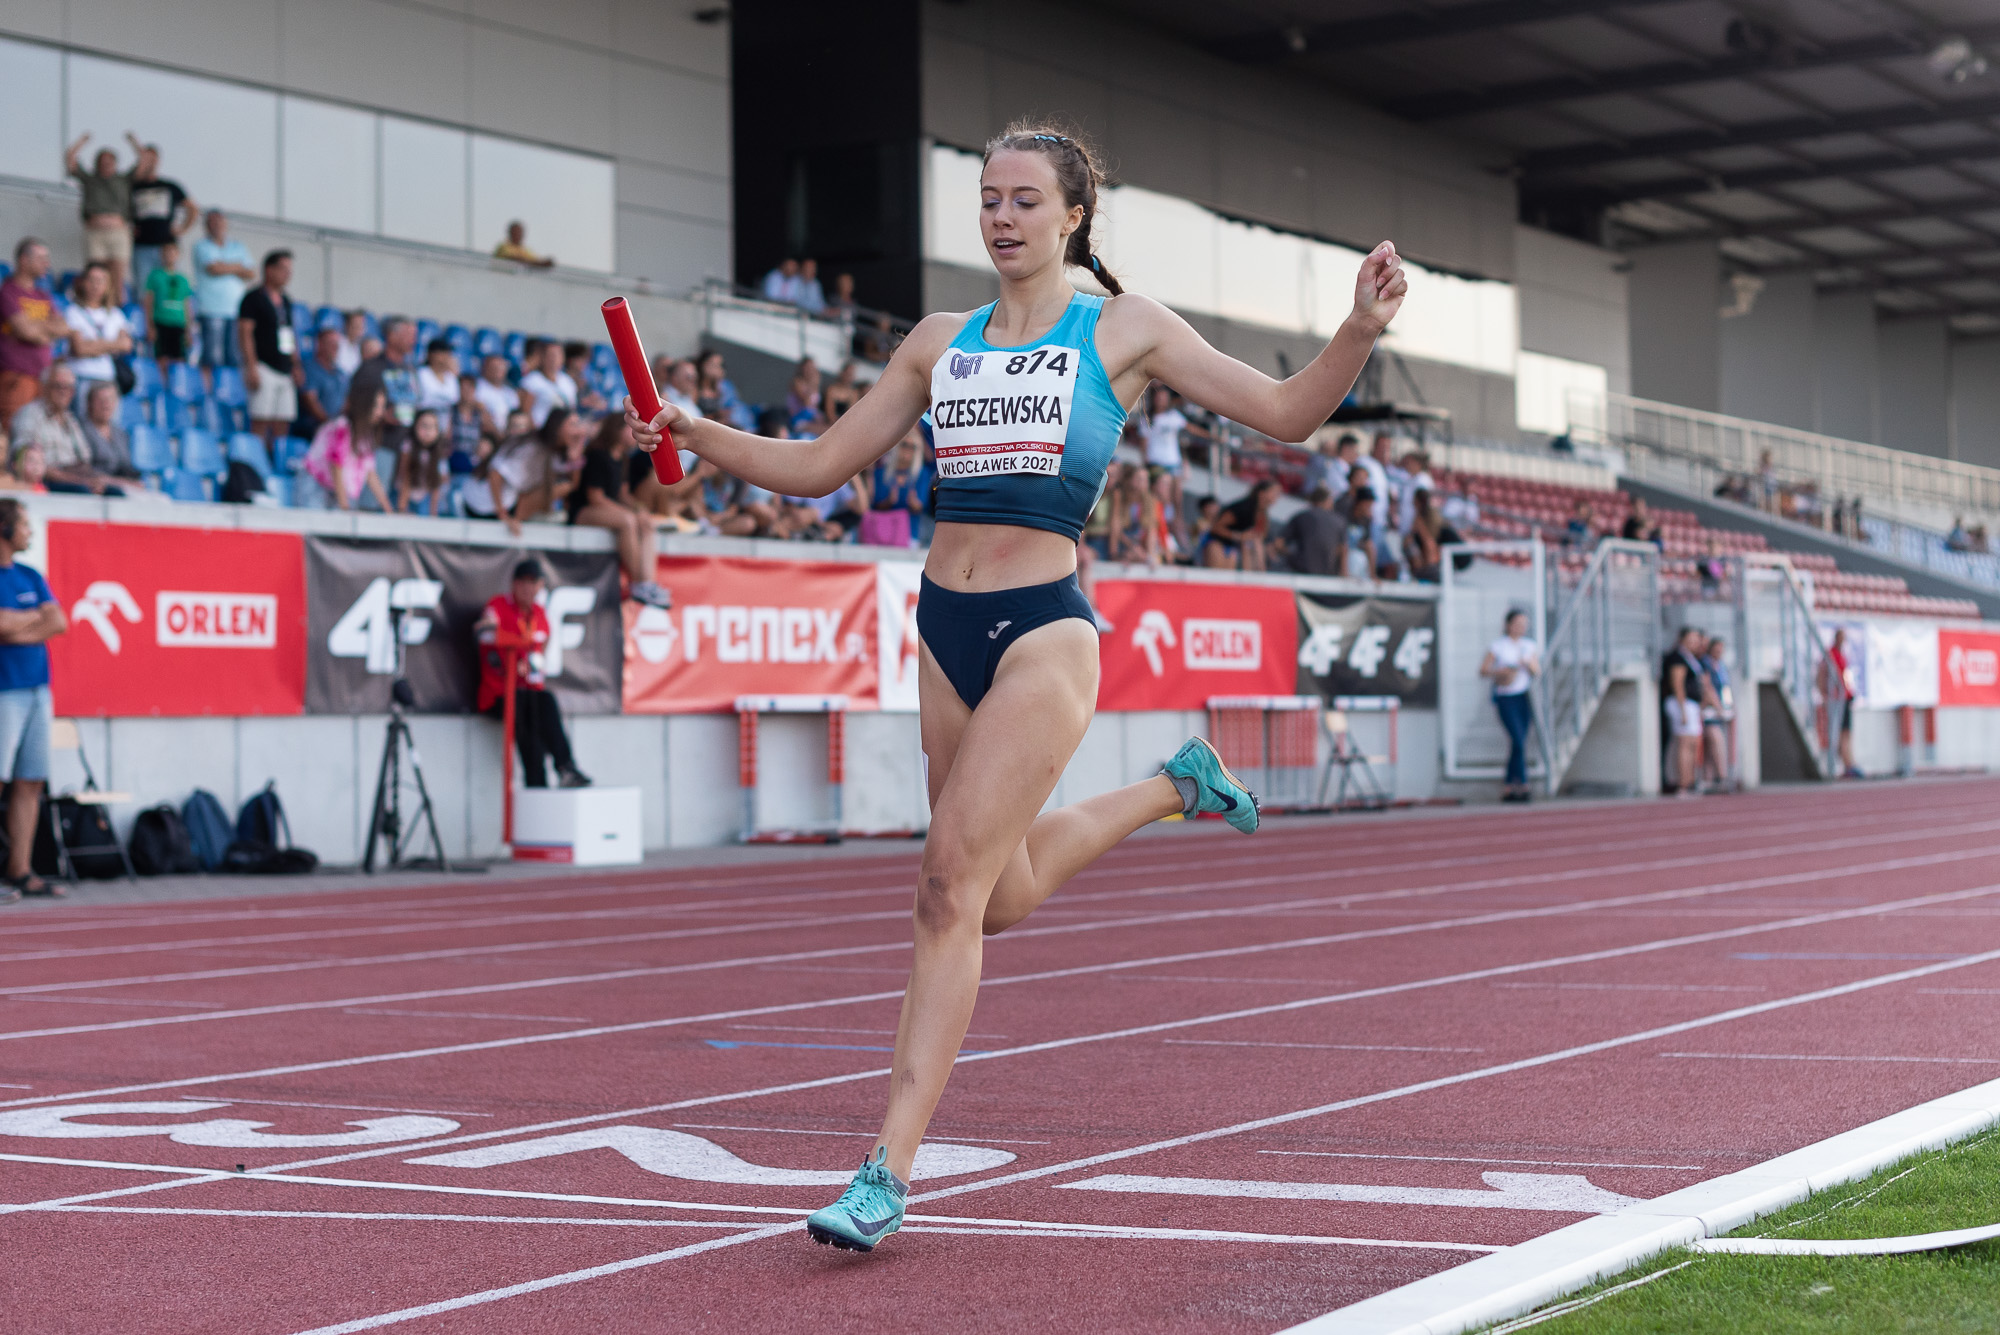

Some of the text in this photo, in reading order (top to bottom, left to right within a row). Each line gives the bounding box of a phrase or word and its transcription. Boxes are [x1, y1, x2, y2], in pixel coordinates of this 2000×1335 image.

[1005, 350, 1068, 377] 874
[934, 395, 1063, 430] CZESZEWSKA
[964, 444, 1015, 454] MISTRZOSTWA
[1015, 443, 1044, 451] POLSKI
[941, 456, 1054, 476] WŁOCŁAWEK 2021
[167, 604, 267, 636] ORLEN
[327, 577, 444, 674] 4F
[1298, 624, 1435, 680] 4F 4F 4F
